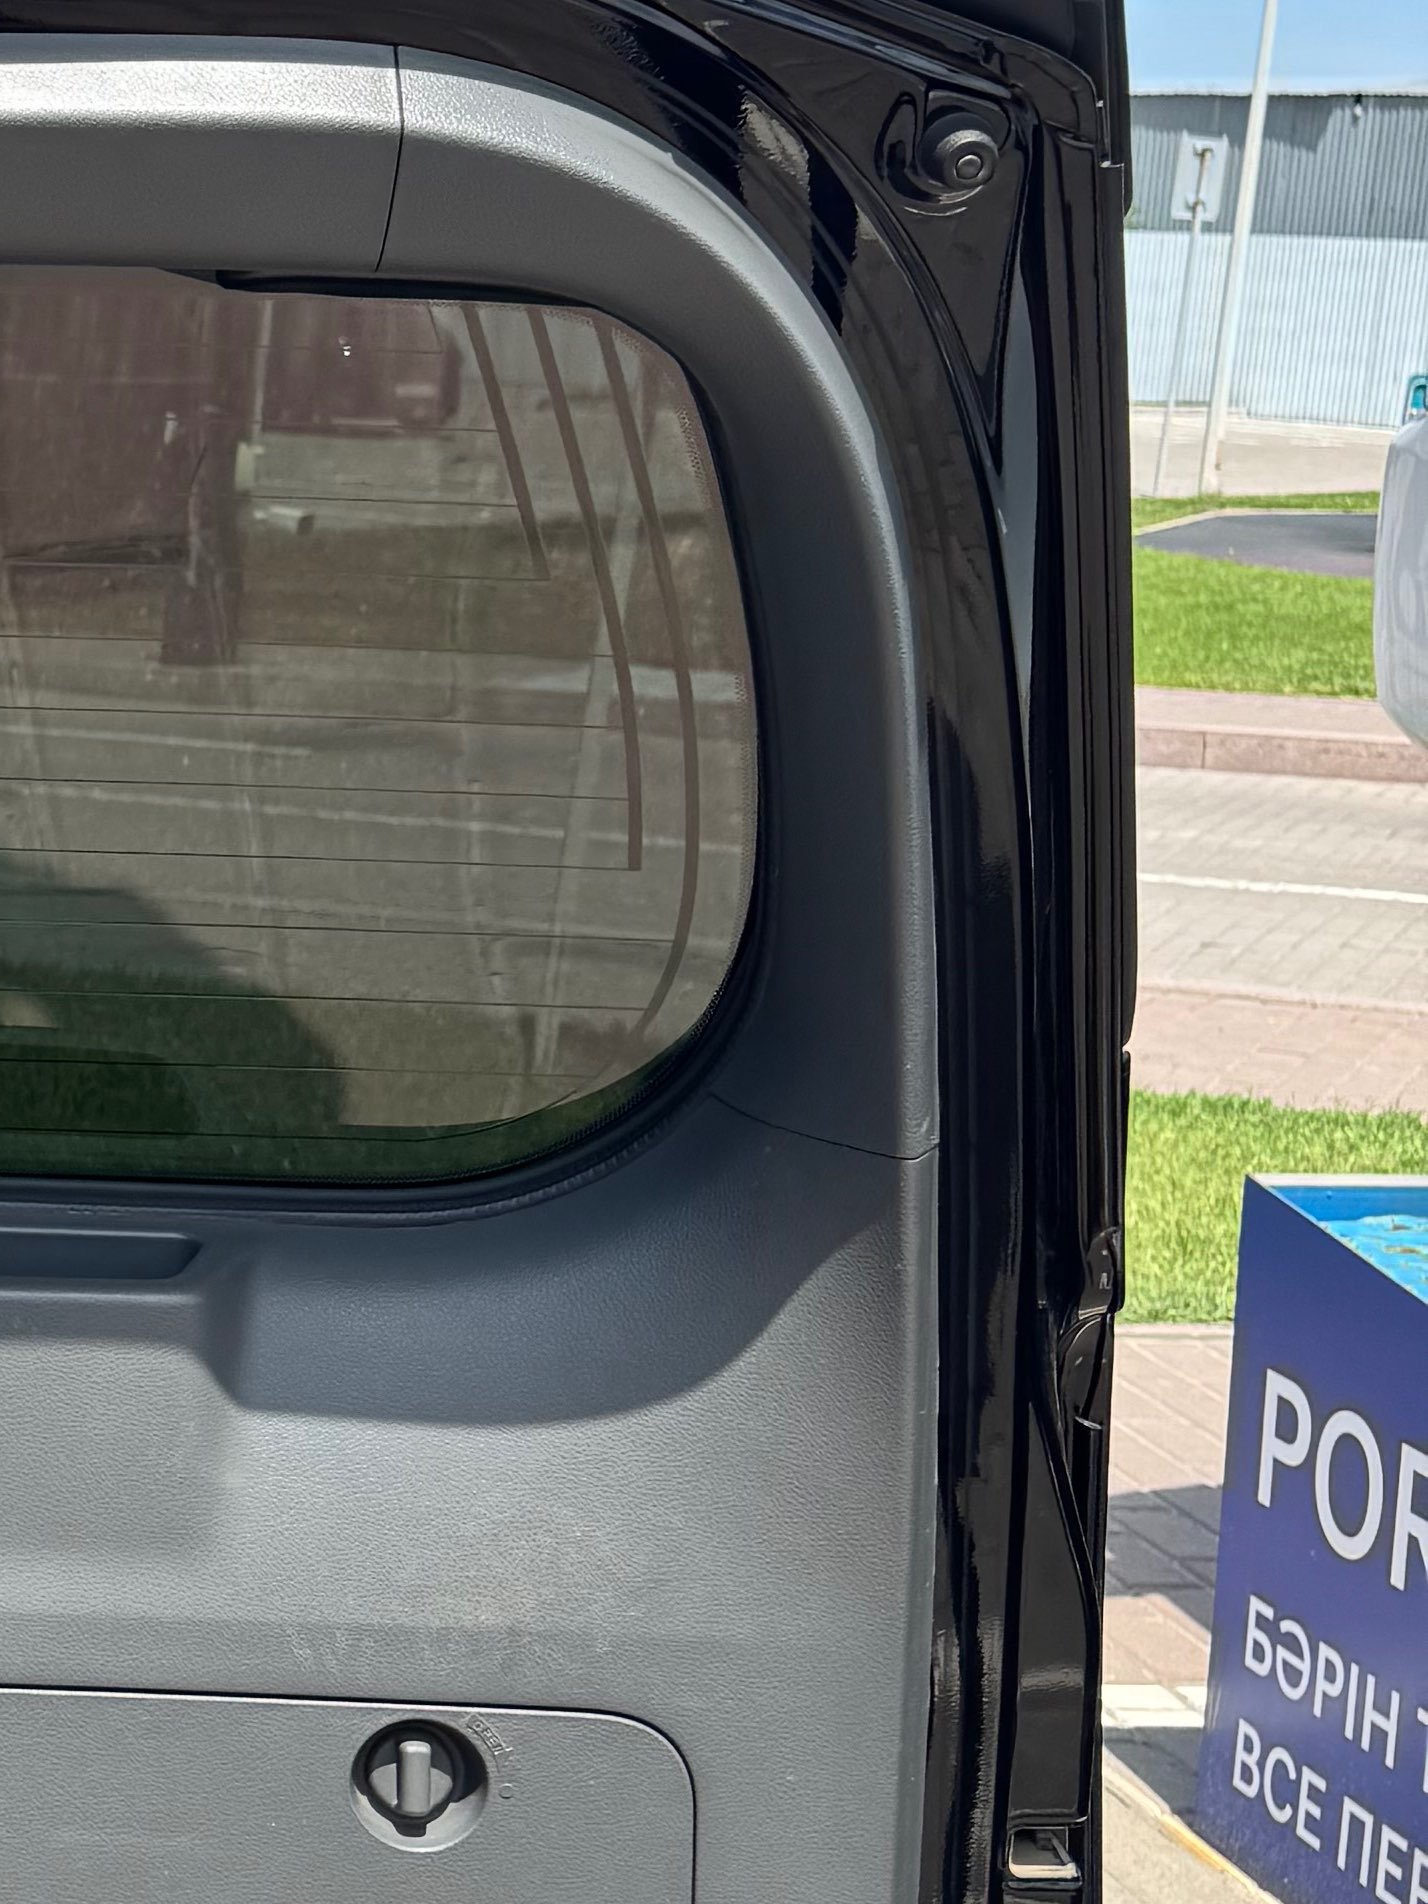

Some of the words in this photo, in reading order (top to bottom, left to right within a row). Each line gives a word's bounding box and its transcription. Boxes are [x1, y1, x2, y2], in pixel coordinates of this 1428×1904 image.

[1256, 1368, 1428, 1591] POR
[472, 1719, 504, 1752] OPEN
[1244, 1595, 1400, 1770] БӘРІН
[1231, 1717, 1325, 1853] ВСЕ
